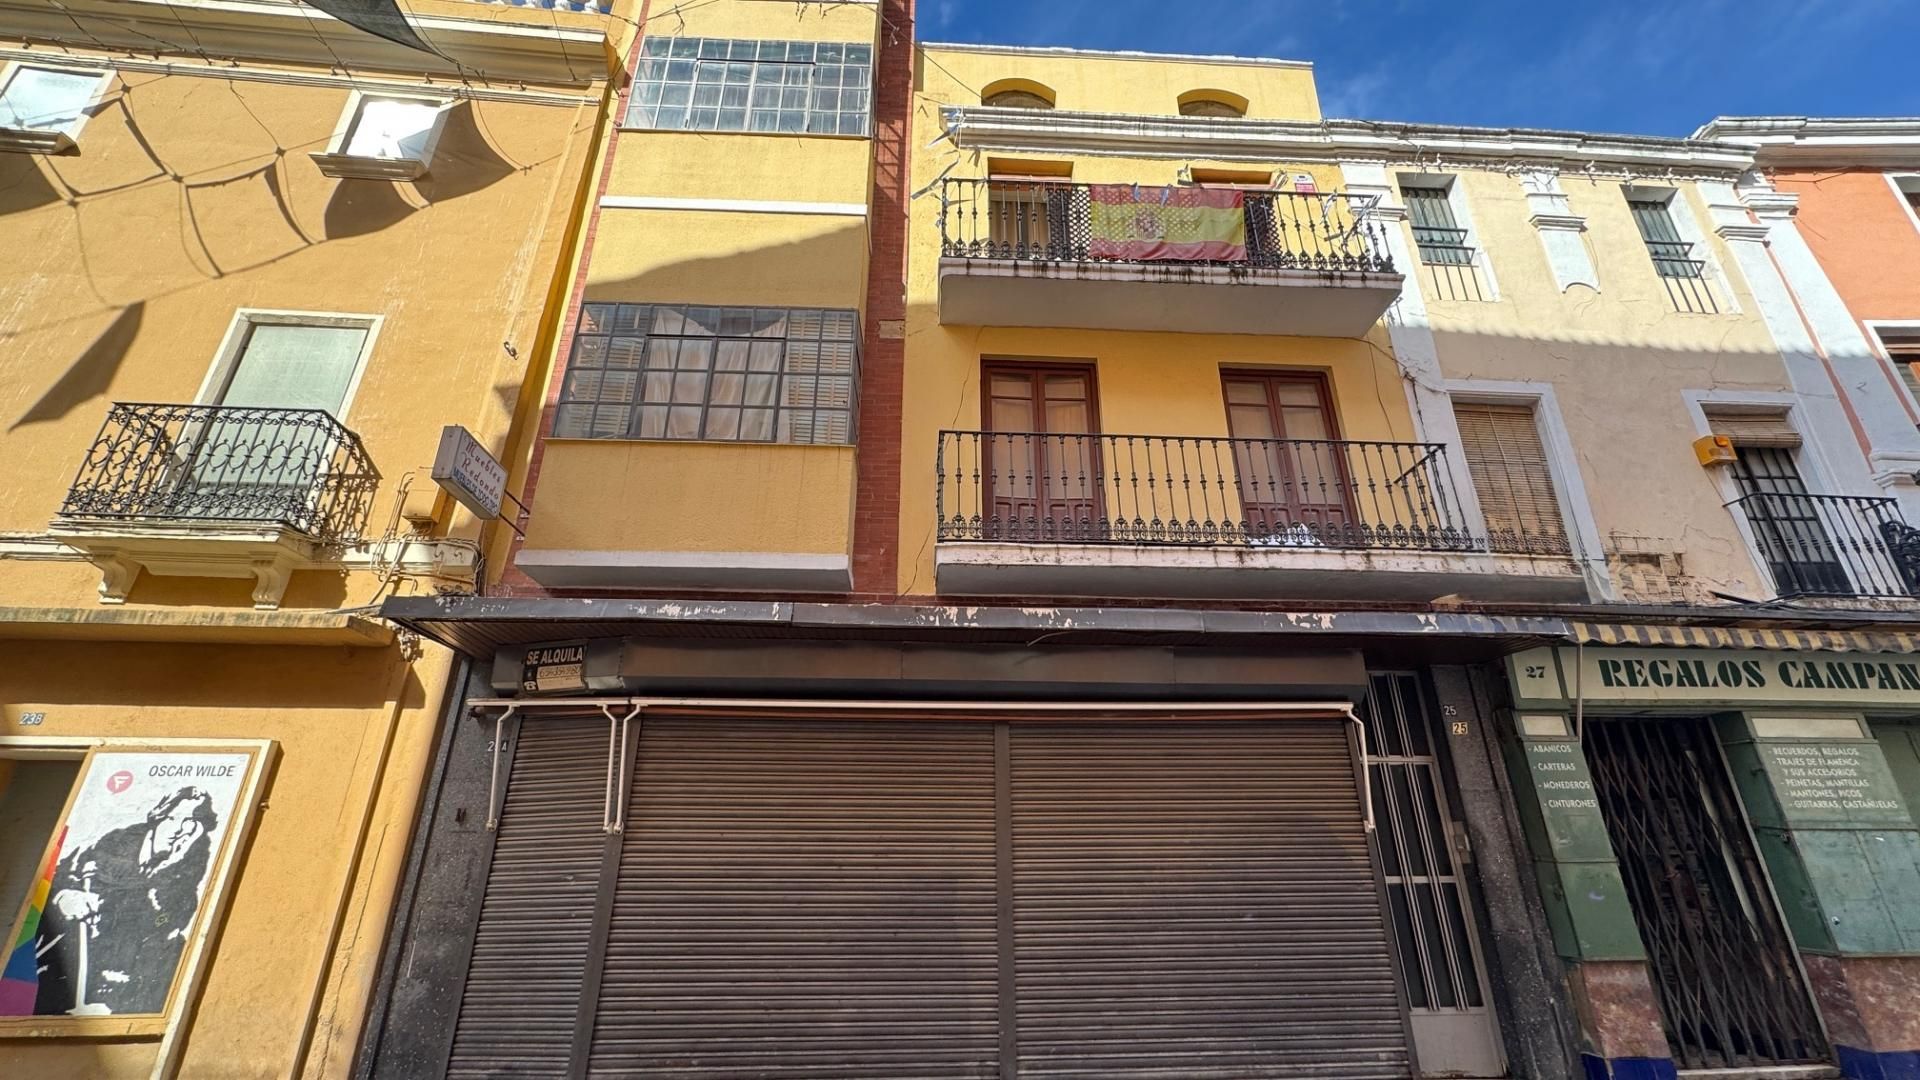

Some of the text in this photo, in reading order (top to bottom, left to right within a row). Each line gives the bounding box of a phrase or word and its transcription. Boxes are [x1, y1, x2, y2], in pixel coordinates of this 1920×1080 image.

[464, 436, 501, 483] Muebles
[461, 451, 499, 501] Redondo
[526, 647, 583, 665] SE ALQUILA
[1525, 665, 1546, 679] 27
[1598, 659, 1920, 690] REGALOS CAMPAN
[1443, 705, 1457, 716] 25
[1453, 722, 1468, 735] 25
[487, 740, 508, 752] 2A
[1533, 744, 1572, 753] ABANICOS
[1822, 747, 1859, 756] REGALOS
[1537, 762, 1576, 771] CARTERAS
[1776, 757, 1806, 766] TRAJES
[1807, 757, 1818, 766] DE
[149, 765, 236, 777] OSCAR WILDE
[1790, 768, 1806, 776] SUS
[1807, 768, 1857, 777] ACCESORIOS
[1543, 781, 1591, 790] MONEDEROS
[1826, 779, 1870, 787] MANTILLAS
[1548, 799, 1597, 808] CINTURONES
